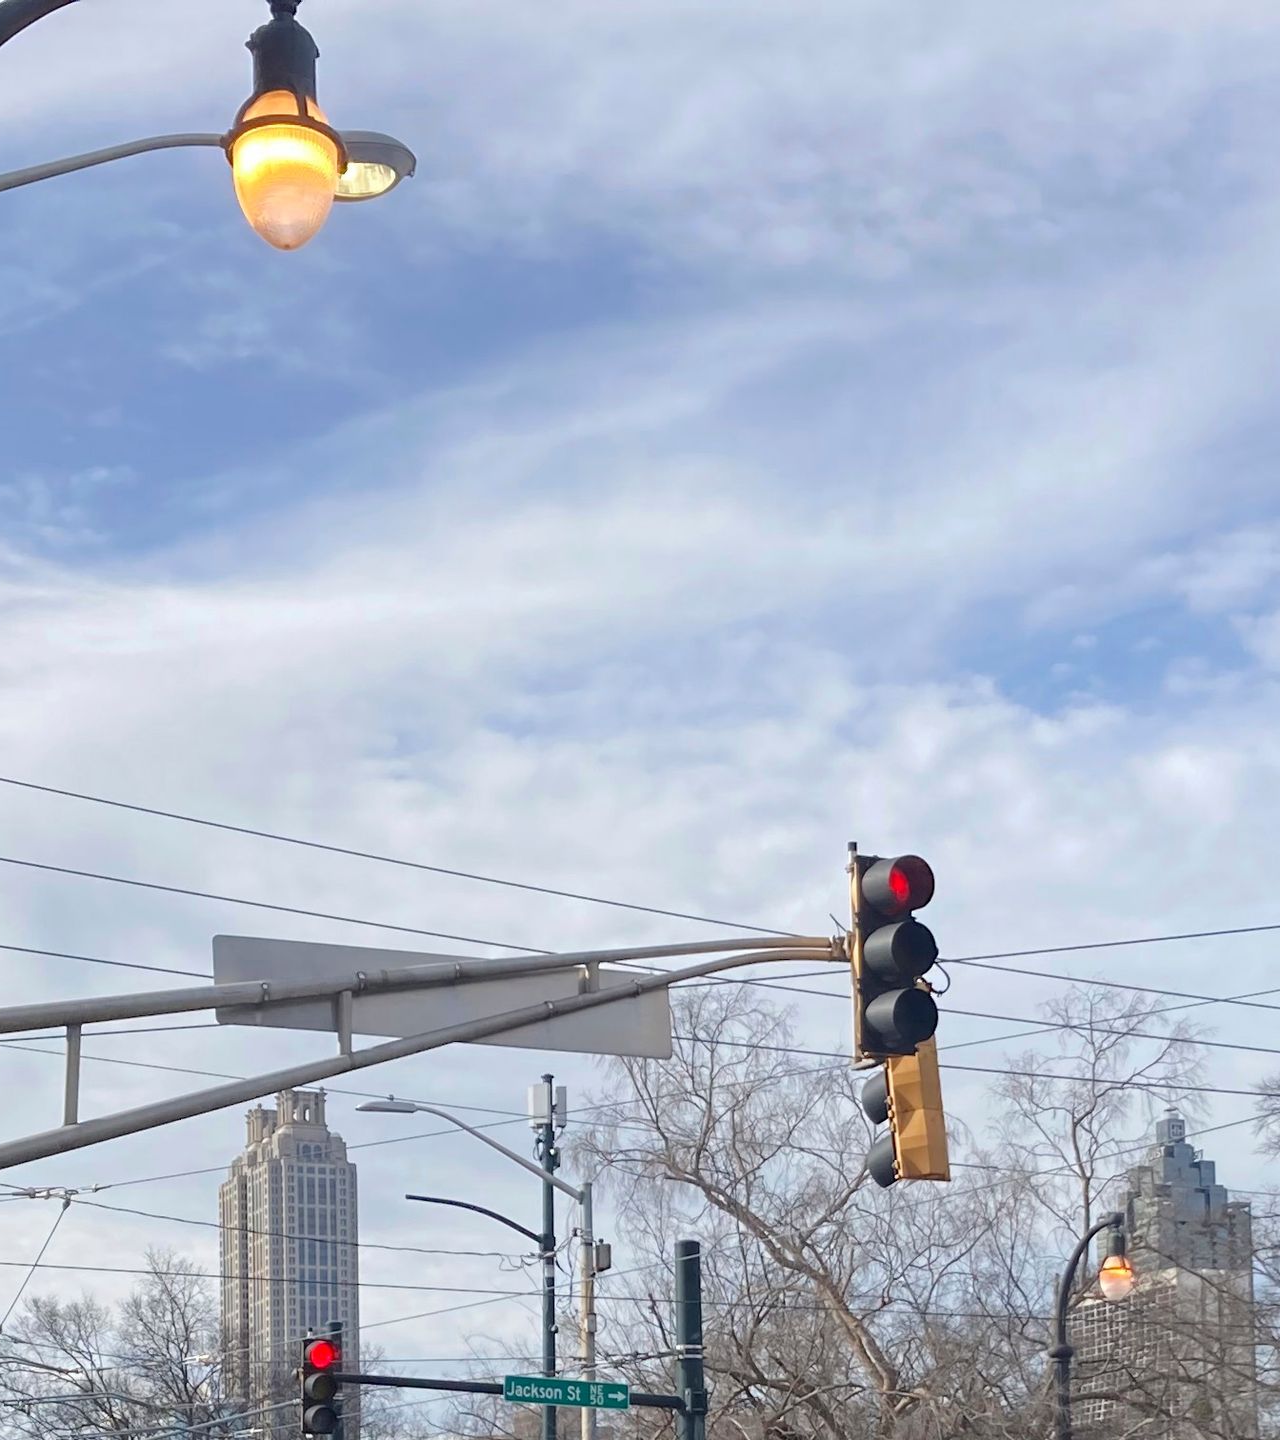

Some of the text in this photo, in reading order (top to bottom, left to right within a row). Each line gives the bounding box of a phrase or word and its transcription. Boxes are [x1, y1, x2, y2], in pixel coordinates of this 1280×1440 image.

[506, 1381, 604, 1401] Jackson St NE
